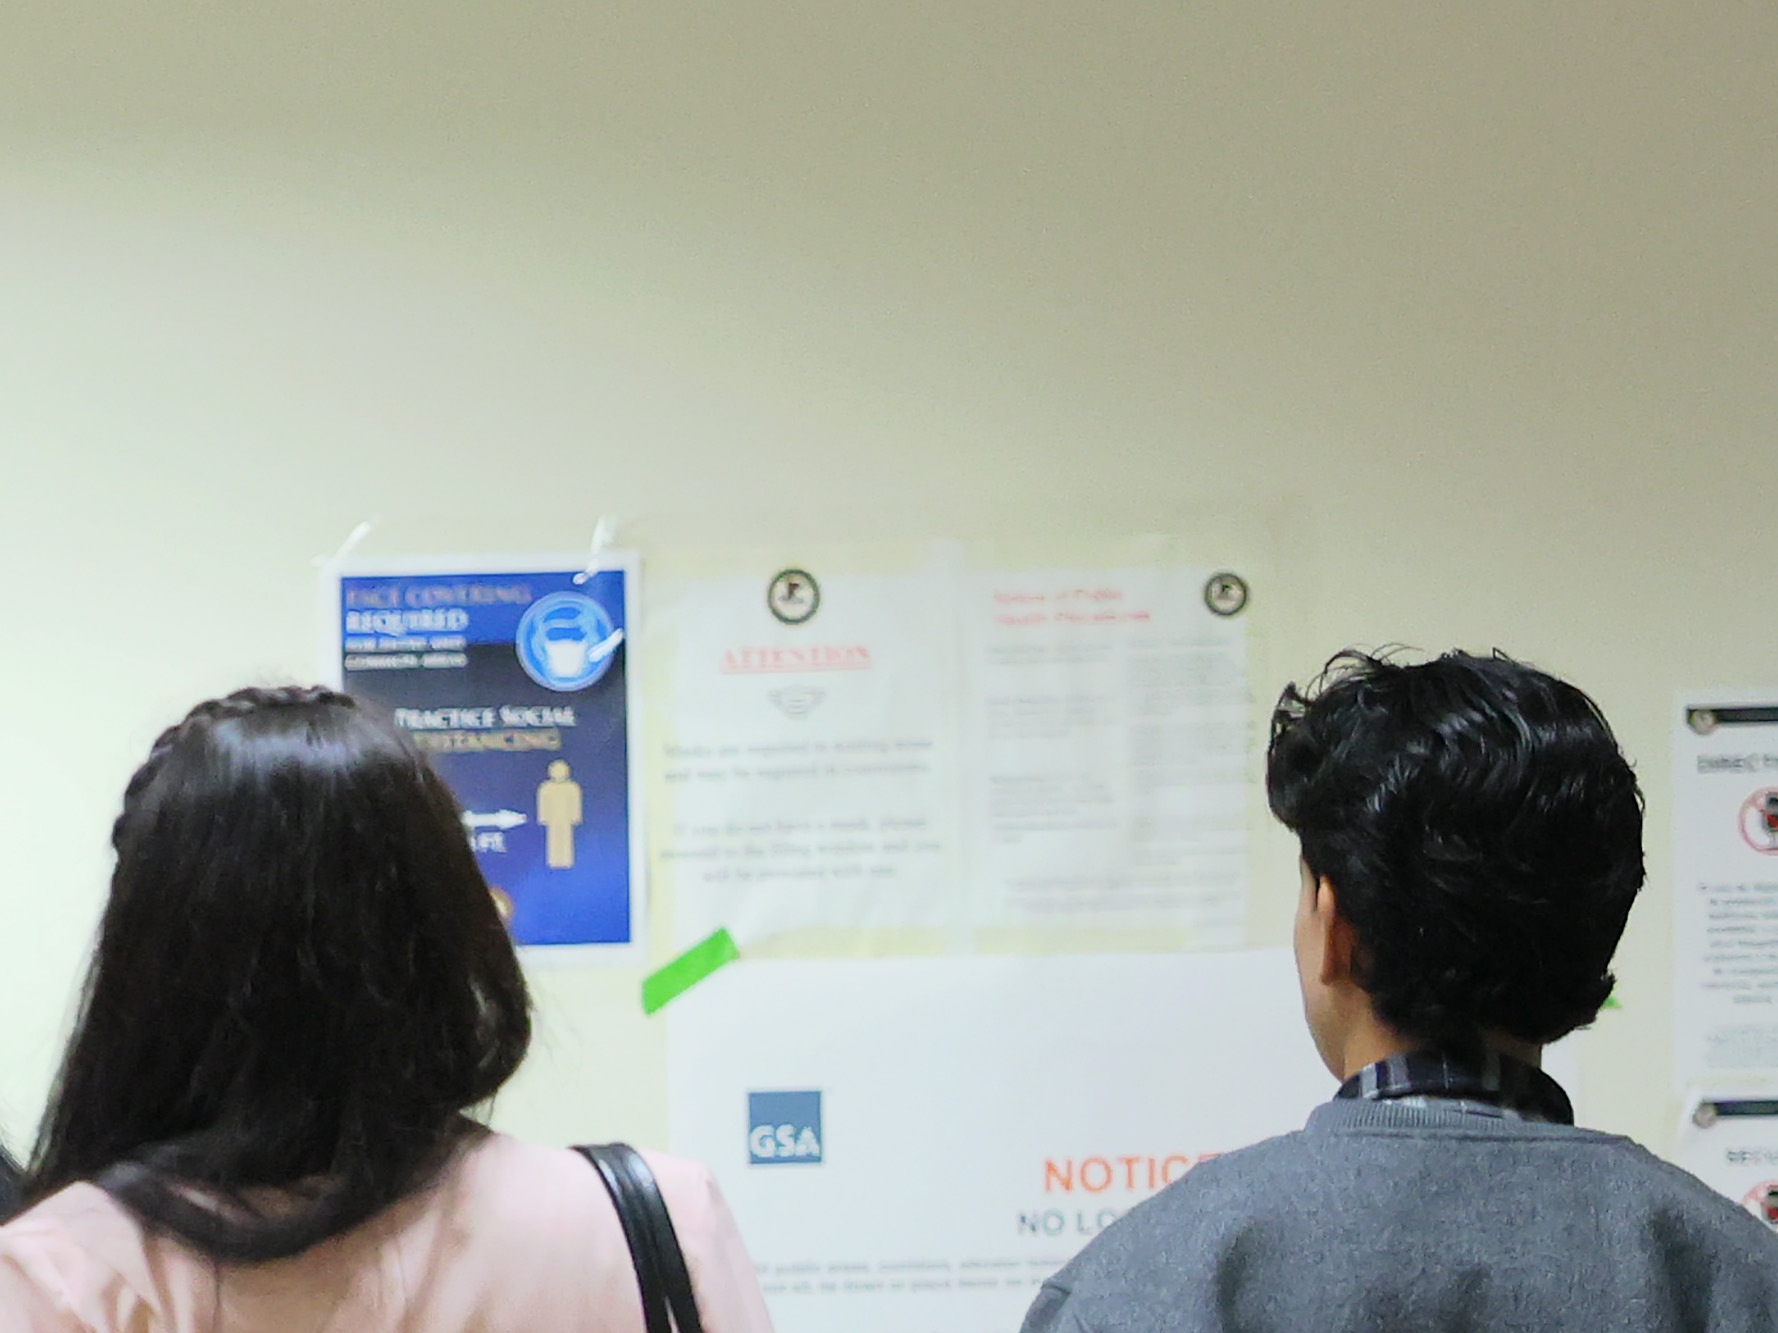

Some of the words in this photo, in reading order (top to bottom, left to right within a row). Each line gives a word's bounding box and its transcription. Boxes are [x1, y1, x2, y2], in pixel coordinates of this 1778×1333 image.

[749, 1124, 820, 1159] GSA
[1044, 1153, 1222, 1193] NOTIC
[1017, 1207, 1066, 1236] NO
